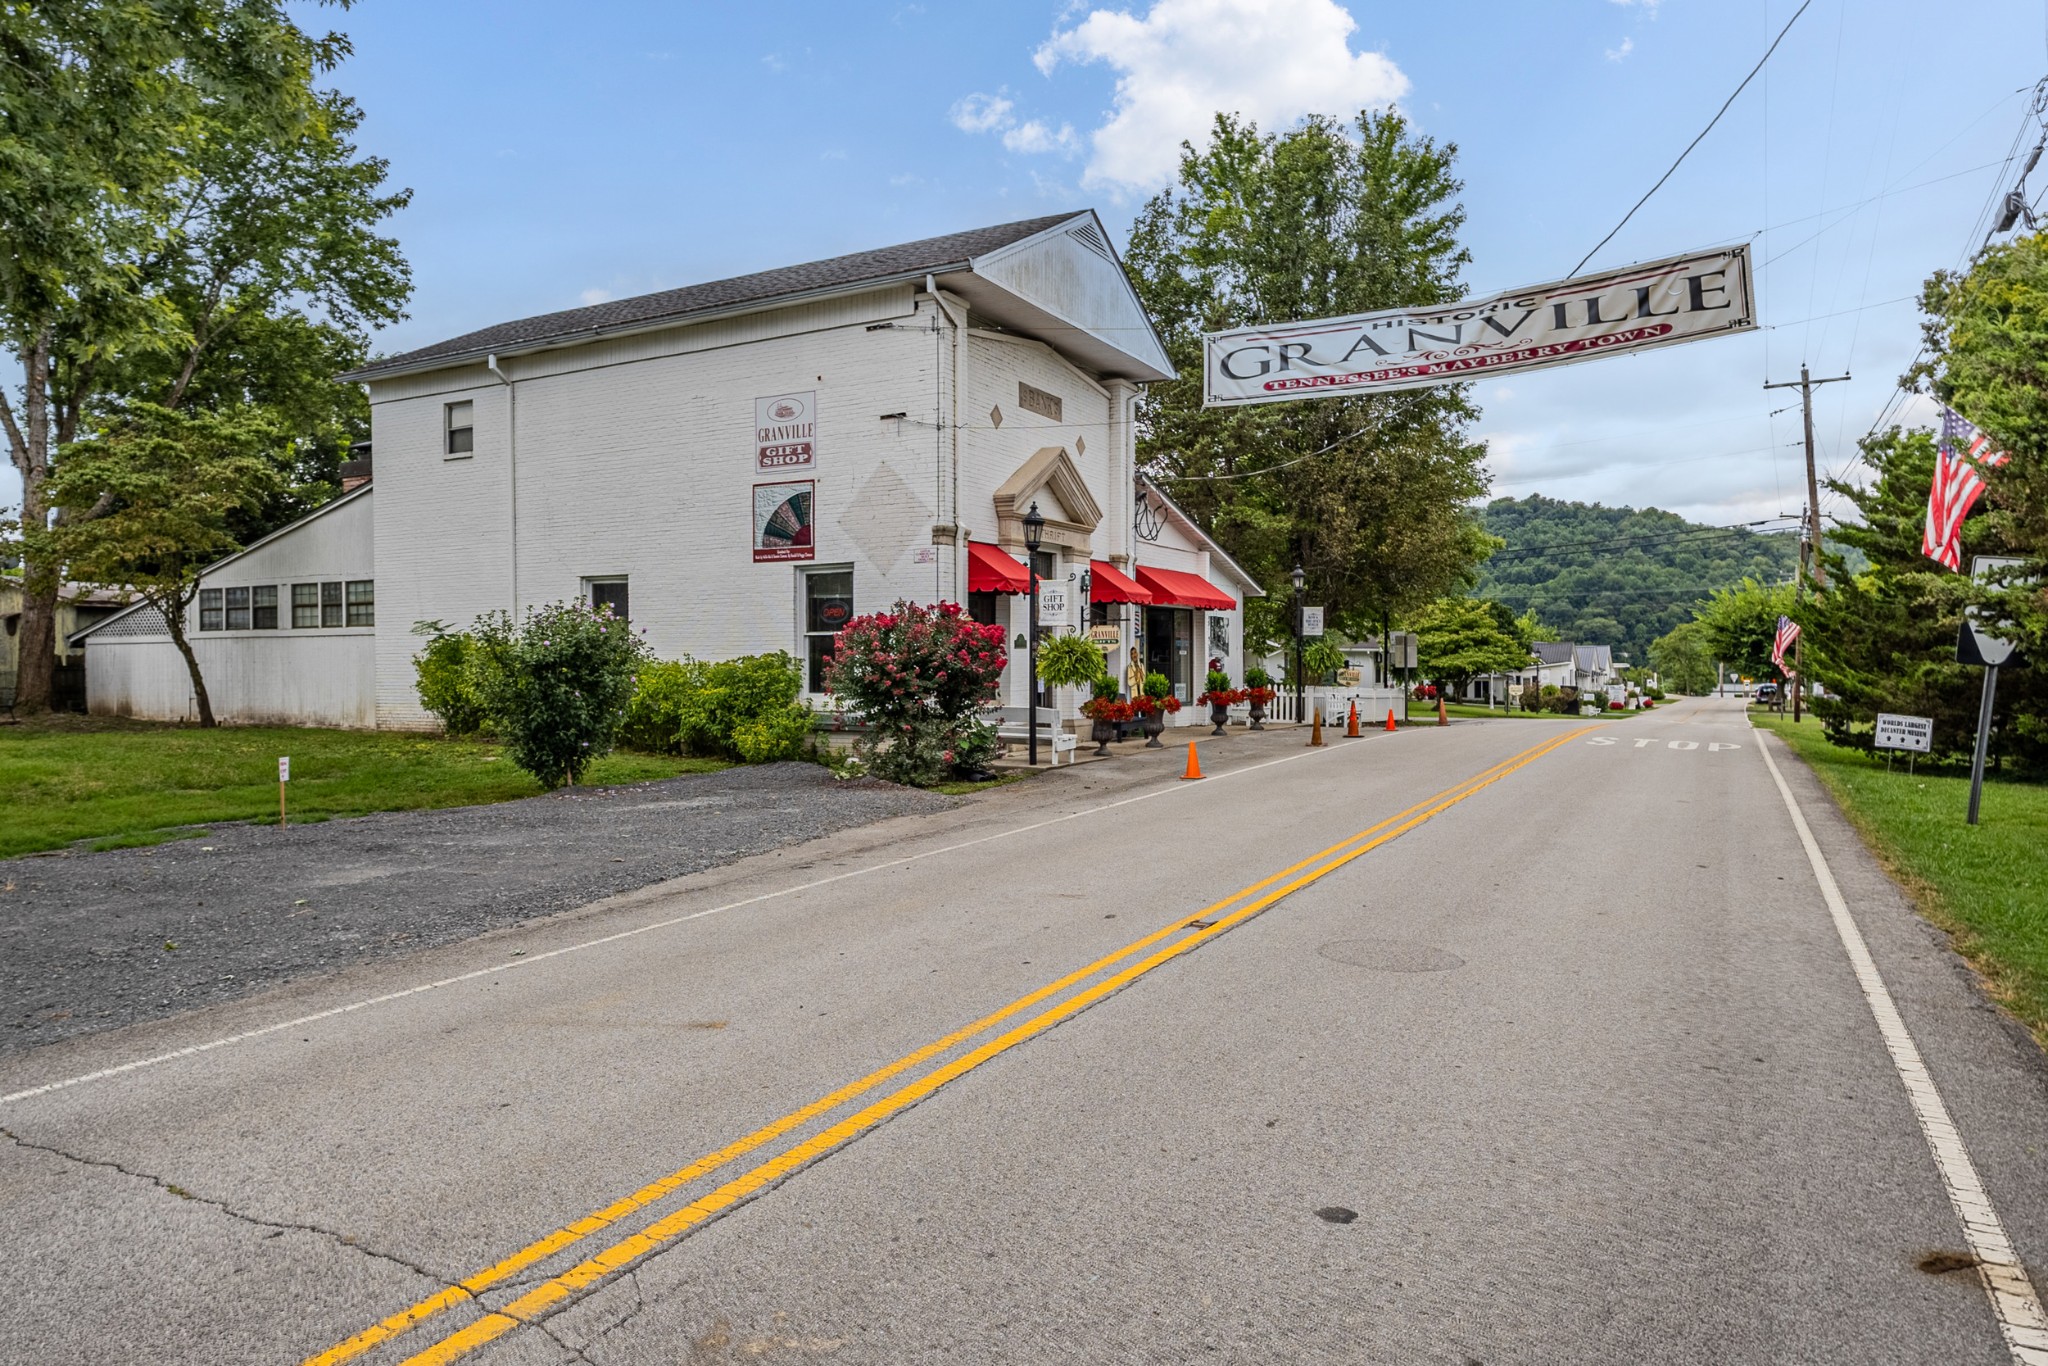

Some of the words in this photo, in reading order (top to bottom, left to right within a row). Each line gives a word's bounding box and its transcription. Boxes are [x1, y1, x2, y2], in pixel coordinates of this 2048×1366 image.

[1372, 298, 1537, 330] HISTORIC
[1219, 269, 1732, 380] GRANVILLE
[1269, 367, 1420, 390] TENNESSEE'S
[1428, 342, 1571, 374] MAYBERRY
[1579, 325, 1662, 349] TOWN
[758, 422, 813, 443] GRANVILLE
[765, 444, 805, 457] GIFT
[762, 453, 809, 466] SHOP
[1043, 594, 1065, 603] GIFT
[823, 607, 845, 617] OPEN
[1042, 602, 1065, 612] SHOP
[1882, 719, 1904, 727] WORLDS
[1904, 720, 1927, 730] LARGEST
[1880, 726, 1906, 735] DECANTER
[1907, 729, 1927, 738] MUSEUM
[1586, 736, 1742, 752] STOP
